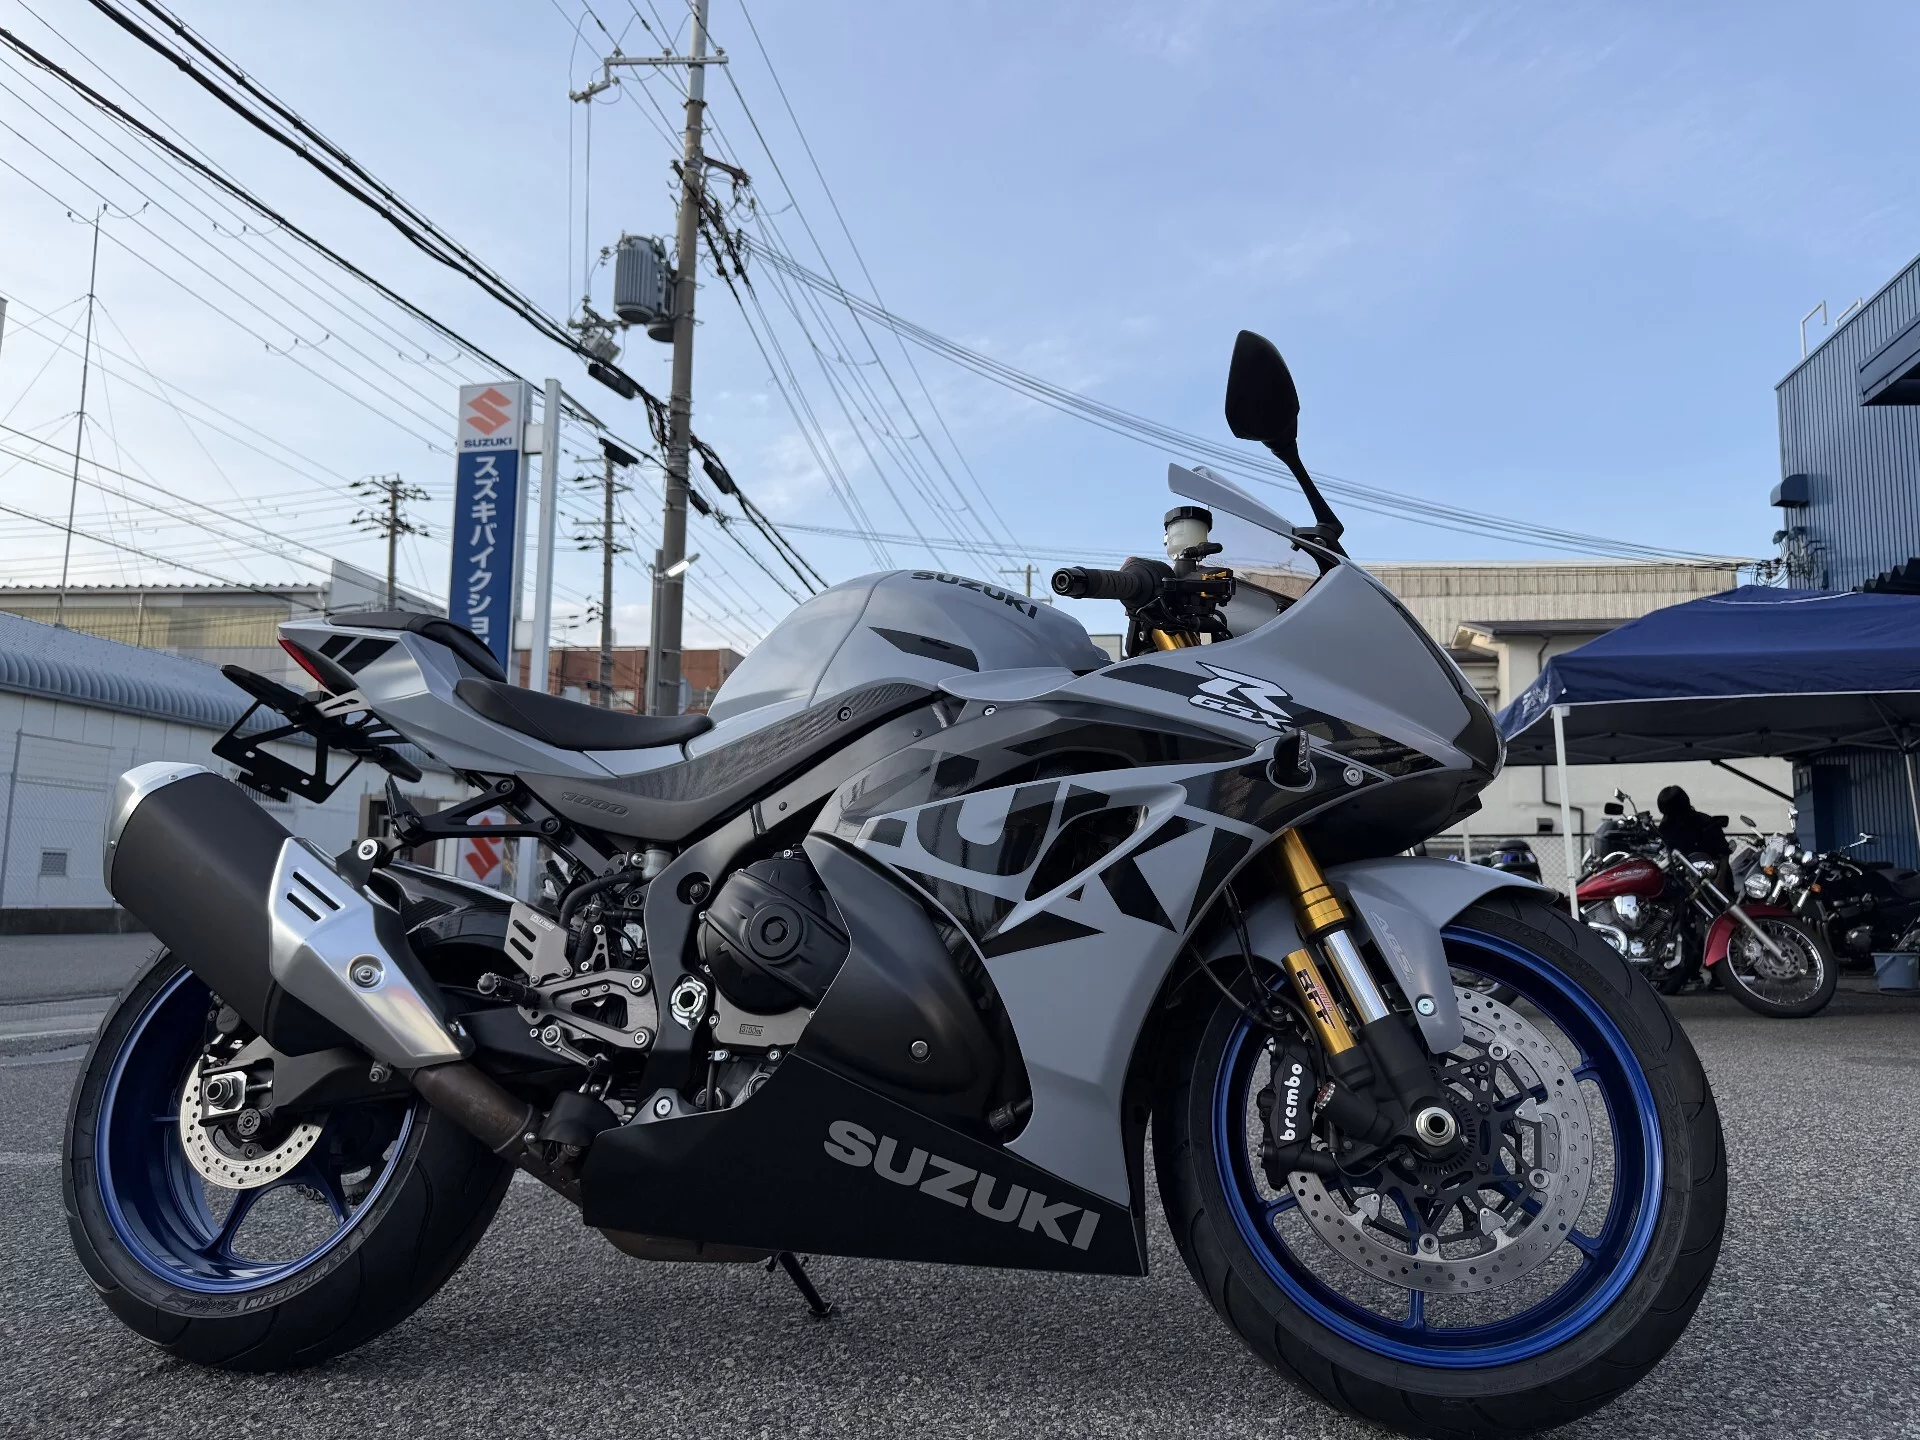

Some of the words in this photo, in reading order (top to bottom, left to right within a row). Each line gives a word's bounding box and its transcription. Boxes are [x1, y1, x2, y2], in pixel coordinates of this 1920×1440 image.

[464, 437, 512, 448] SUZUKI
[467, 455, 500, 646] スズキバイクショ
[911, 571, 1038, 619] SUZUKI
[562, 791, 629, 817] 1000
[1280, 1063, 1303, 1142] brembo
[823, 1120, 1100, 1251] SUZUKI
[246, 1261, 330, 1311] MICHELIN
